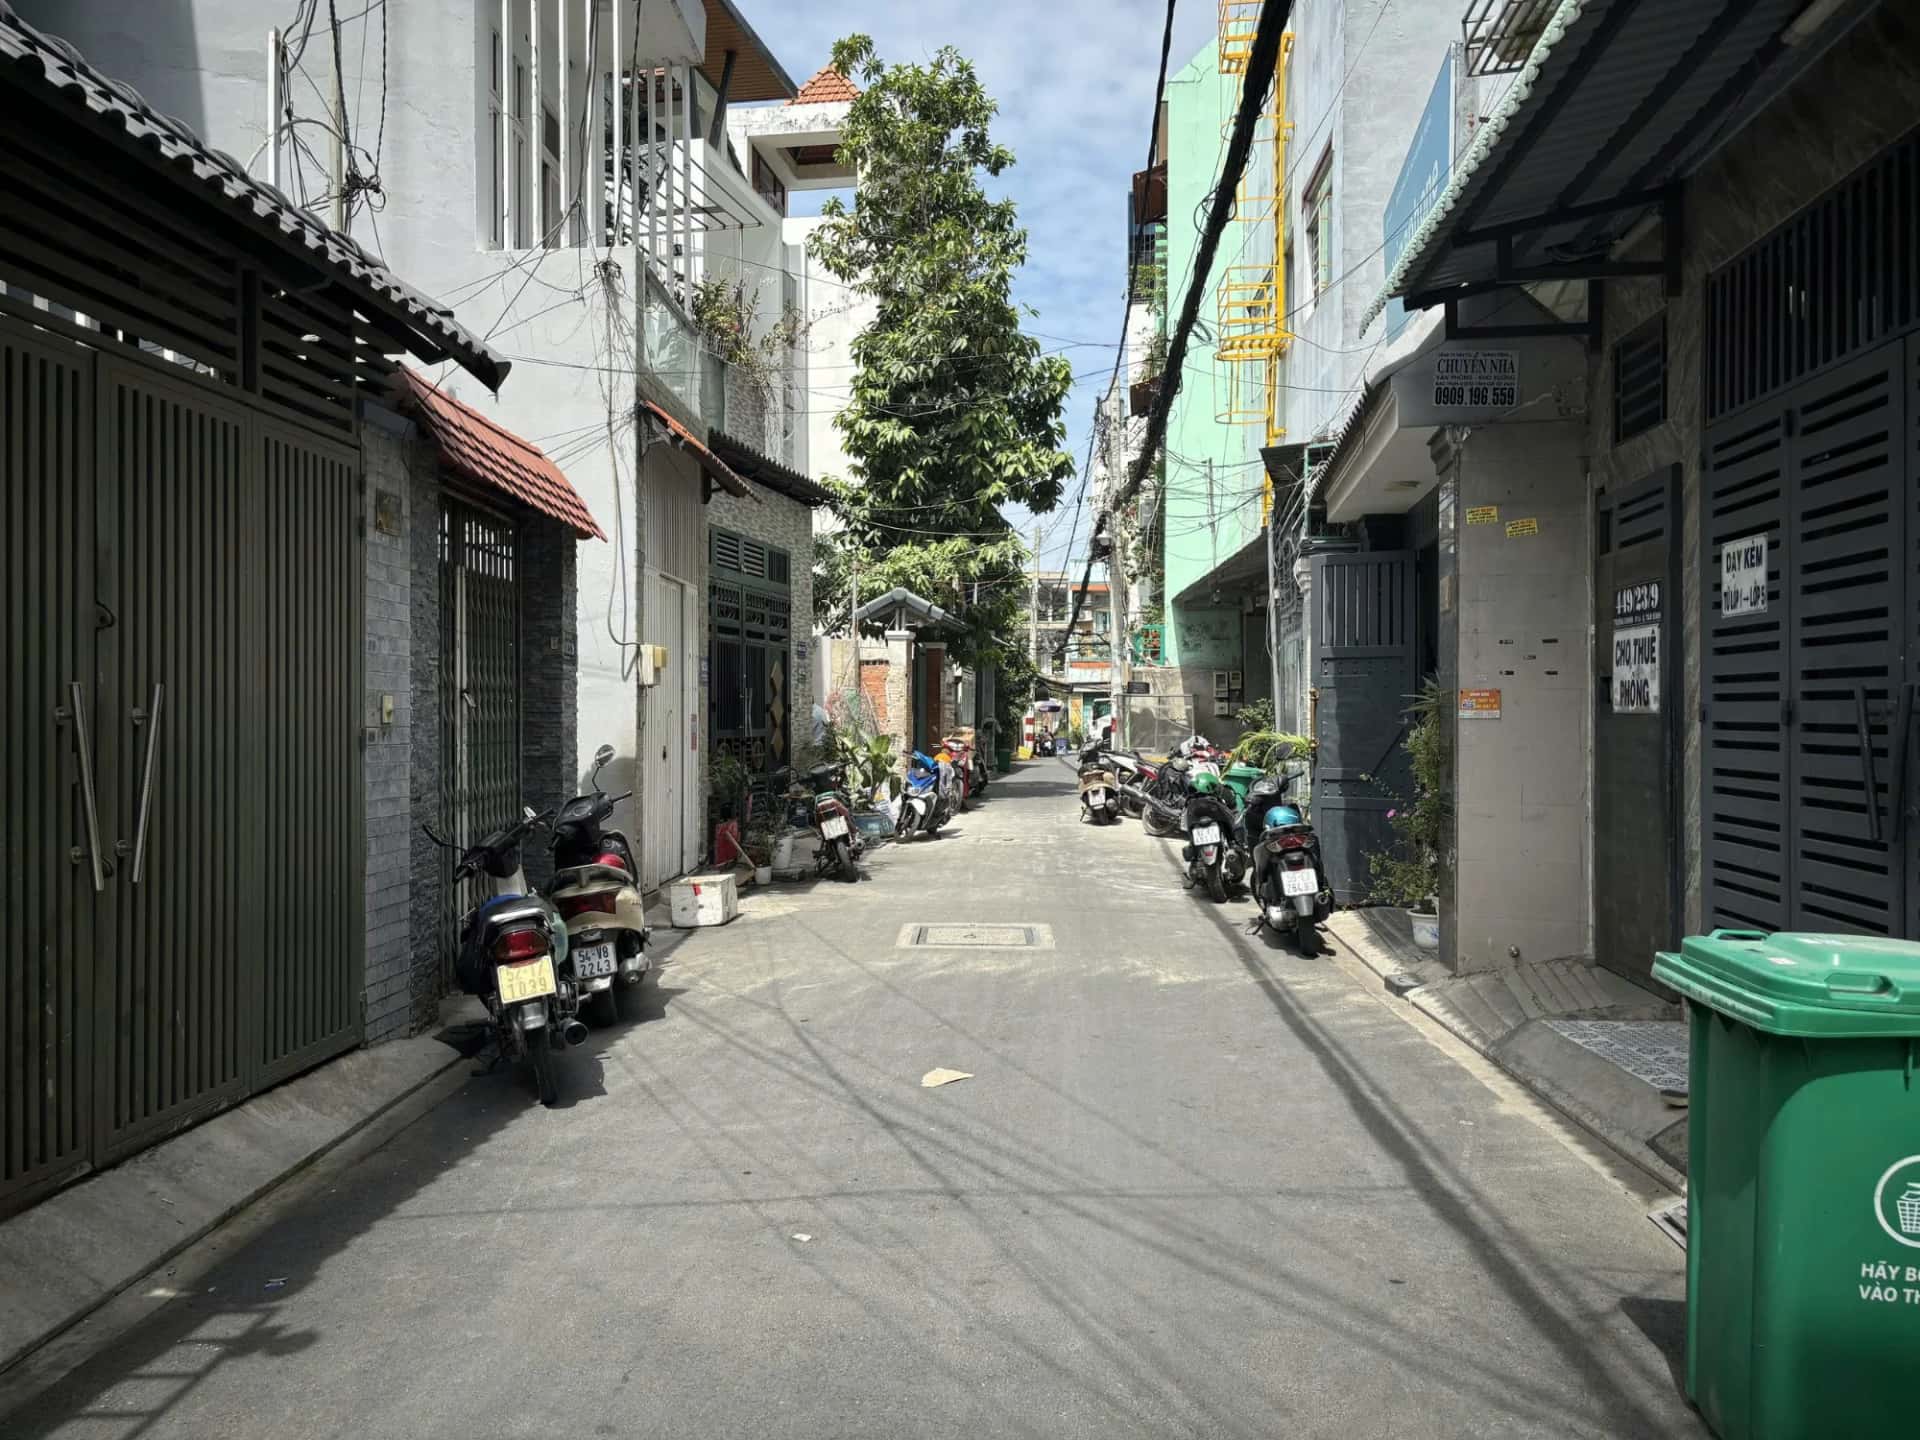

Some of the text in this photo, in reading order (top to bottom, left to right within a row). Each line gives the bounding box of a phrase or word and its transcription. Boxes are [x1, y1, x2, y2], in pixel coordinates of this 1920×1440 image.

[1434, 386, 1515, 406] 0909.196.559
[1726, 549, 1743, 579] DẠY
[580, 959, 611, 977] 2243
[1861, 1260, 1920, 1282] HÃY B
[1859, 1280, 1898, 1302] VÀO
